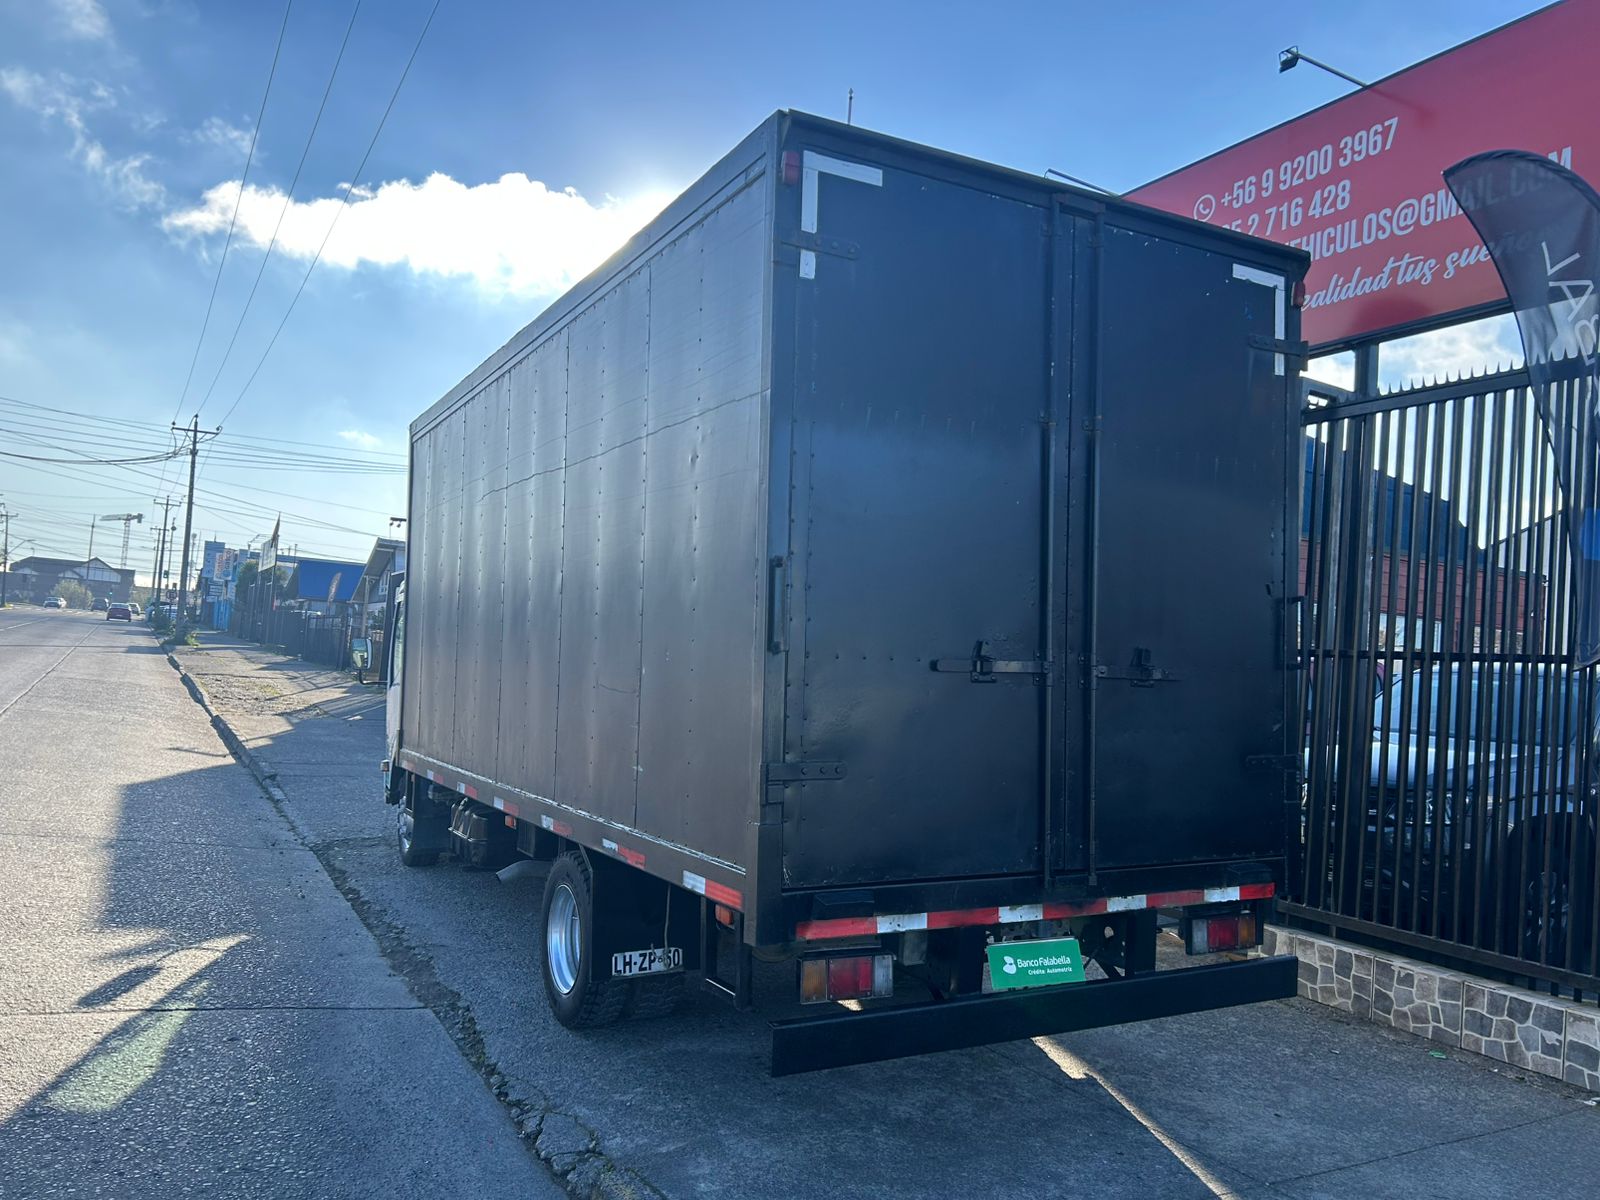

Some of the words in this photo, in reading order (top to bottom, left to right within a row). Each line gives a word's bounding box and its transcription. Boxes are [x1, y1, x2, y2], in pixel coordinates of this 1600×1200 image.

[1221, 175, 1256, 209] +56
[1261, 168, 1274, 198] 9
[1279, 144, 1332, 191] 9200
[1338, 116, 1398, 167] 3967
[1265, 197, 1303, 236] 716
[1308, 179, 1351, 219] 428
[1301, 256, 1393, 311] ealidad
[1396, 252, 1440, 285] tus
[1017, 958, 1039, 968] Banco
[1039, 955, 1071, 966] Falabella
